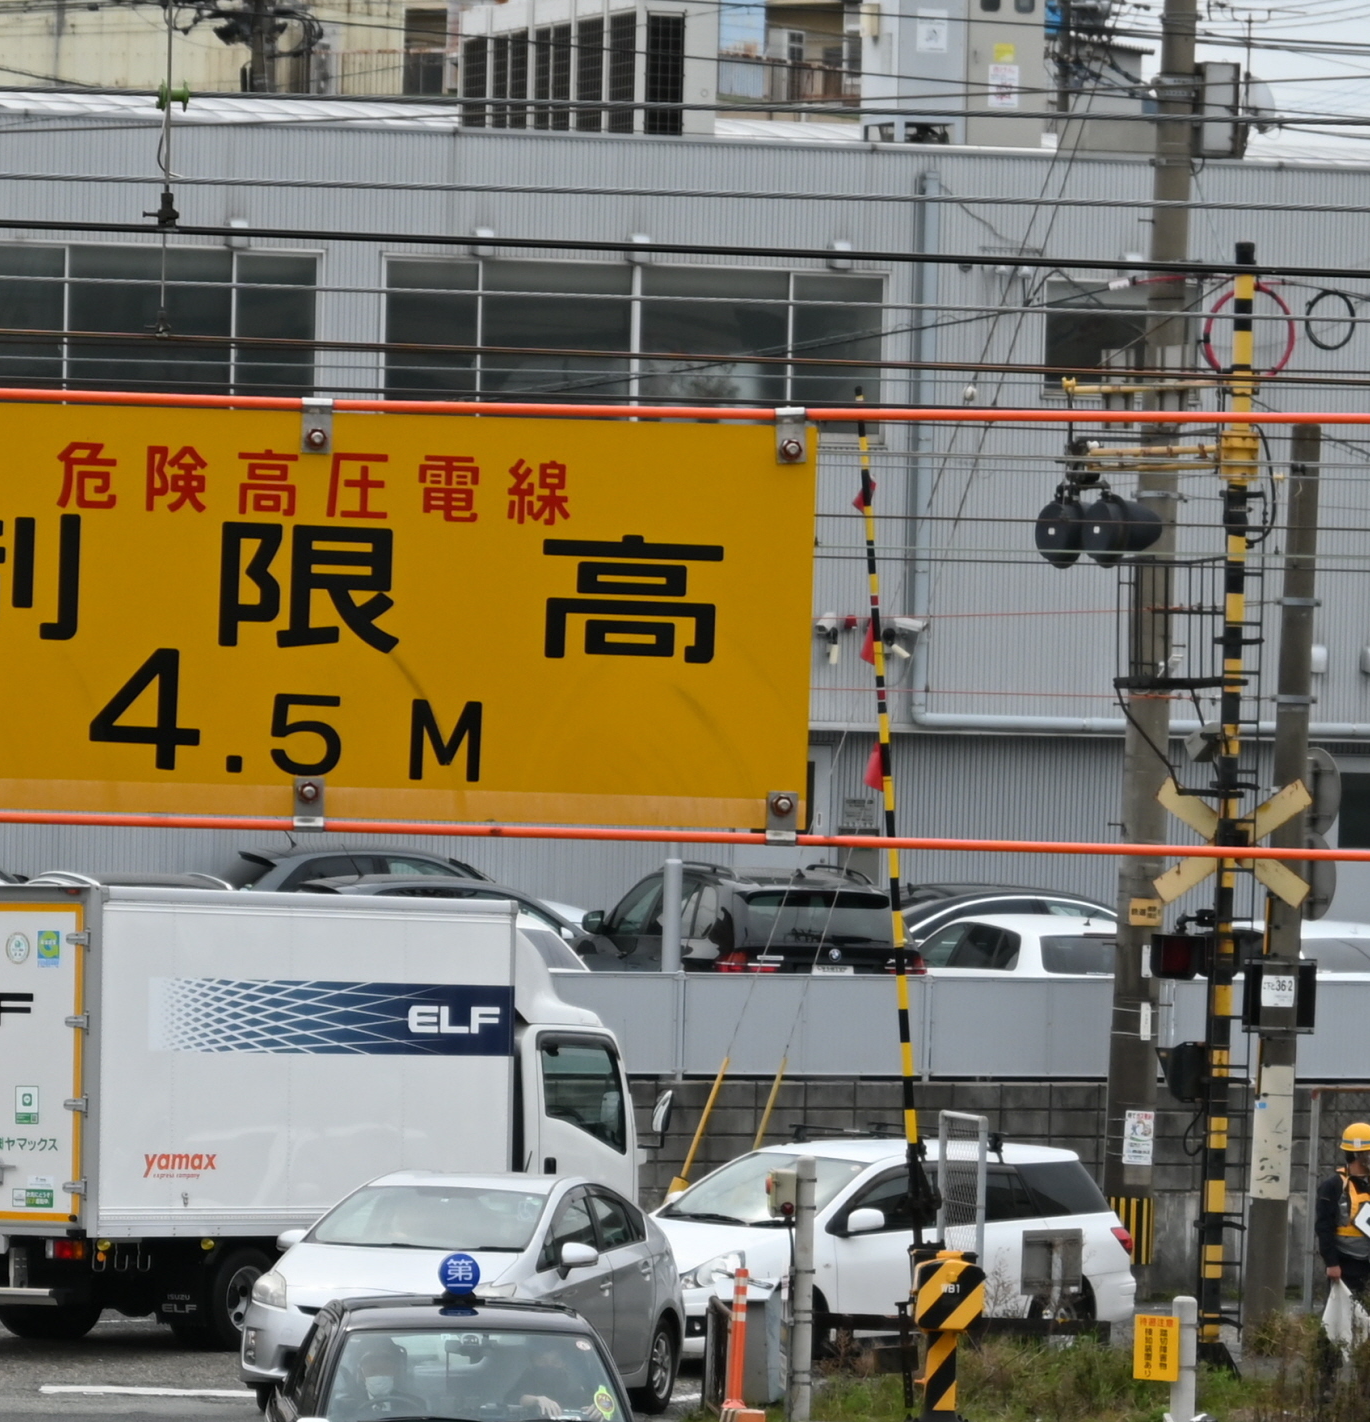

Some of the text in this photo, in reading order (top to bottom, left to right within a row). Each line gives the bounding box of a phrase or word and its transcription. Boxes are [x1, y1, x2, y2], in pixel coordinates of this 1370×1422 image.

[56, 441, 571, 527] 危険高圧電線
[407, 1004, 500, 1036] ELF
[143, 1153, 217, 1178] yamax
[446, 1258, 474, 1287] 第一
[162, 1303, 197, 1314] ELF
